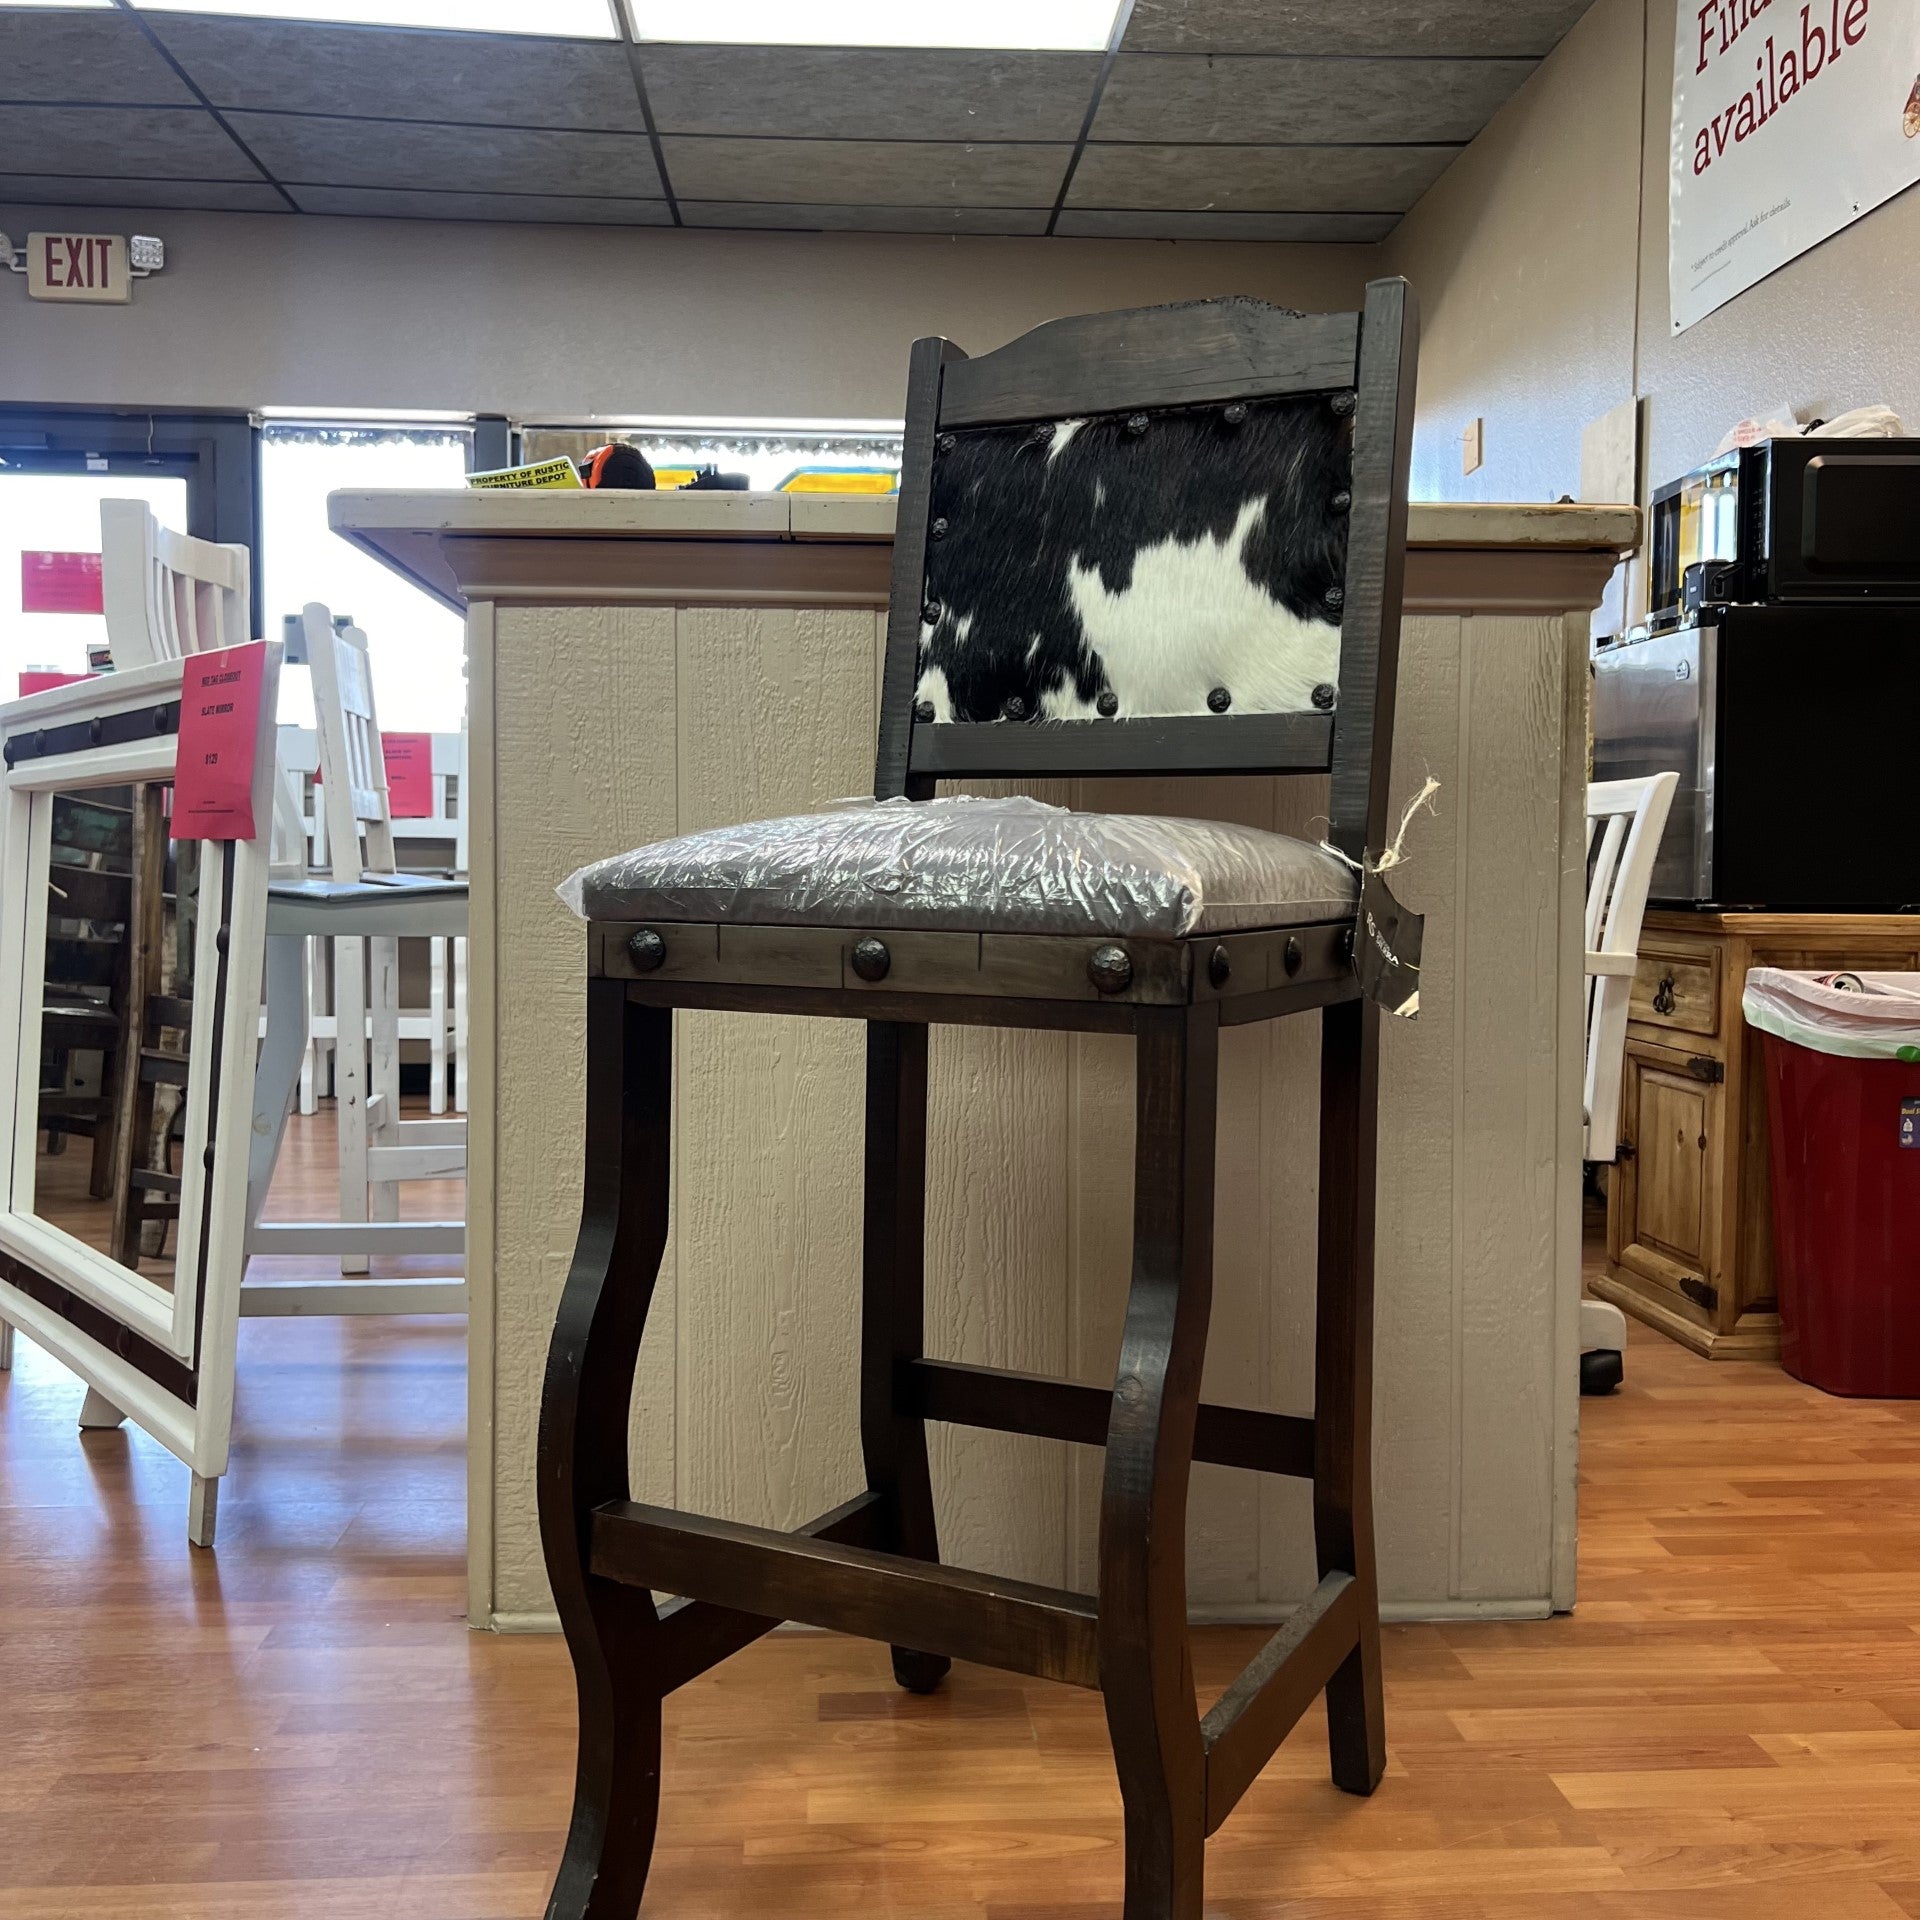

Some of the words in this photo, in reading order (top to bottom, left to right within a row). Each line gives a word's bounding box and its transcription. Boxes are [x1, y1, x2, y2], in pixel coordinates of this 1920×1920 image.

[1693, 0, 1869, 176] available
[45, 236, 112, 289] EXIT
[470, 473, 517, 485] PROPERTY
[520, 470, 532, 478] OF
[534, 461, 569, 476] RUSTIC
[536, 472, 567, 484] DEPOT
